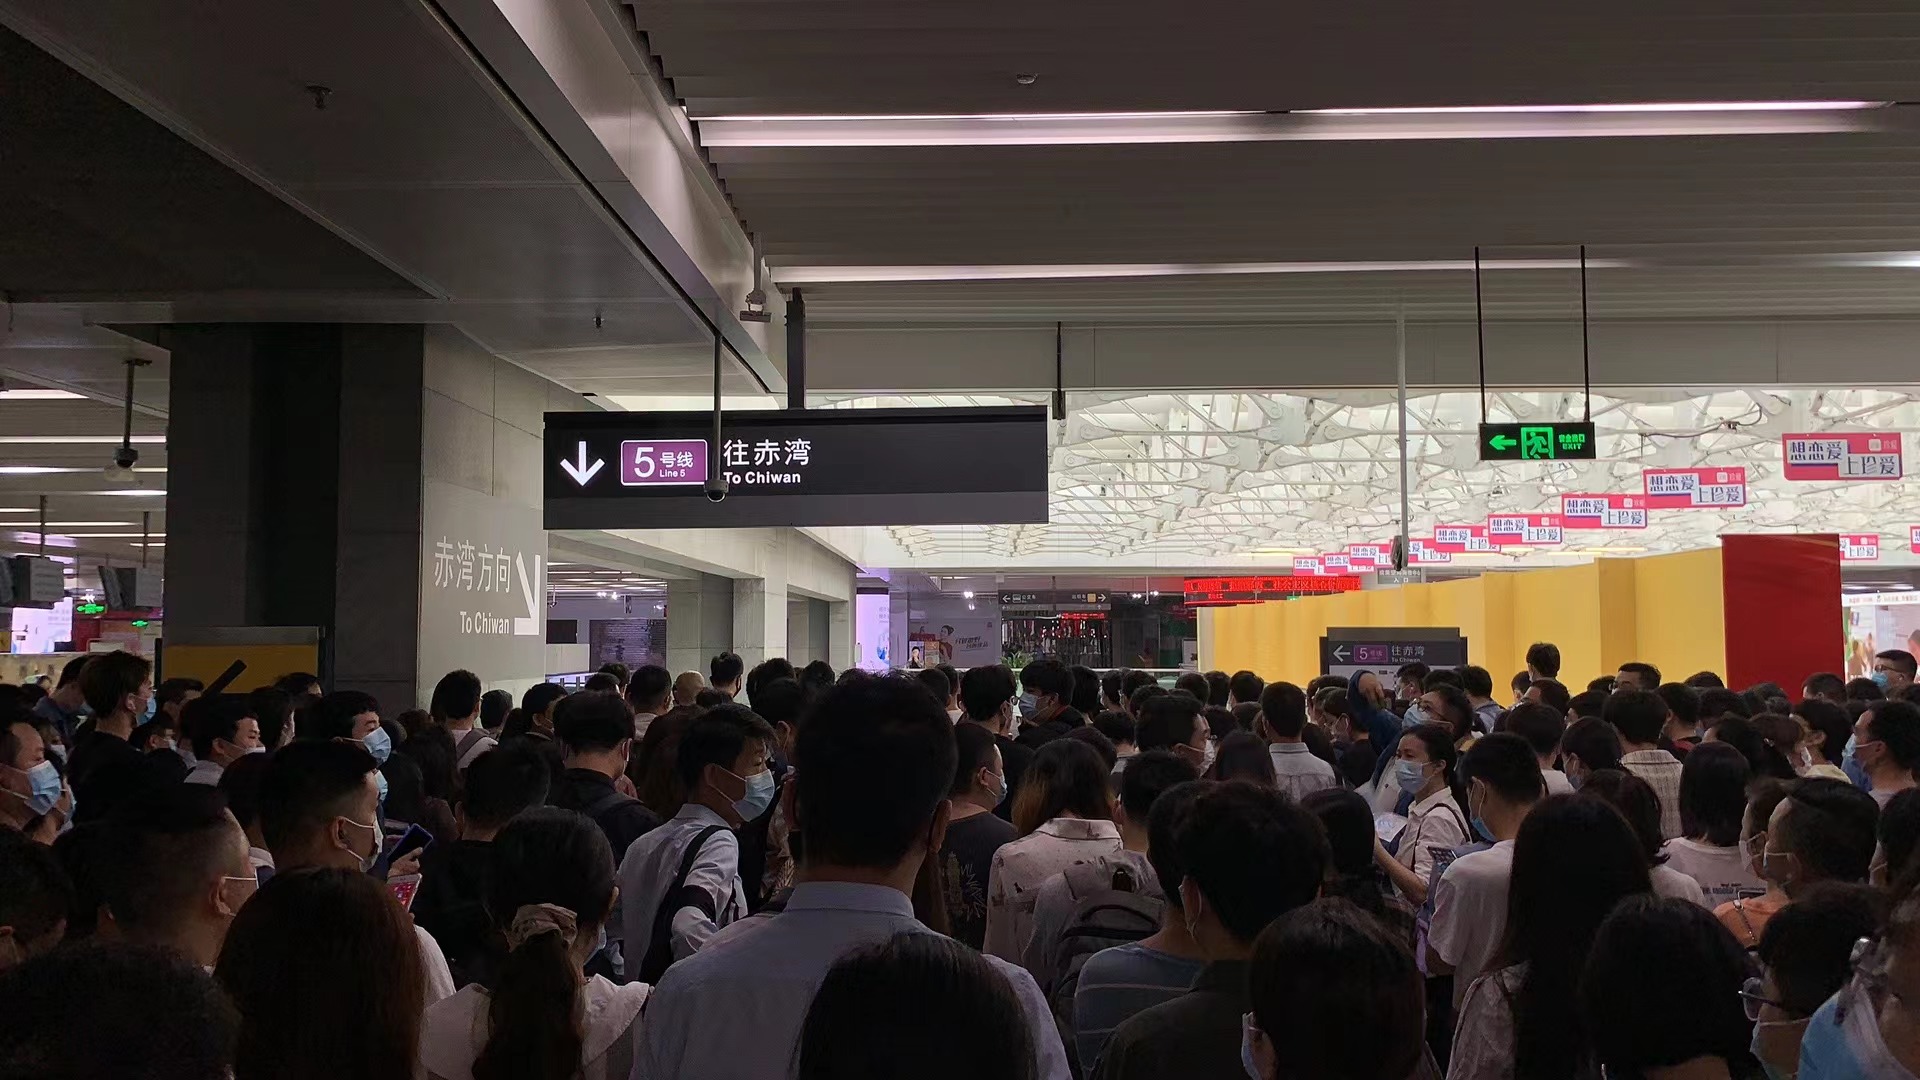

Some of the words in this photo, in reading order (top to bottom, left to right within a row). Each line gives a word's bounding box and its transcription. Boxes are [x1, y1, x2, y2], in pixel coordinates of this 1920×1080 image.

[723, 438, 811, 468] 往赤湾
[1790, 441, 1842, 461] 想恋爱
[659, 468, 678, 478] Line
[679, 468, 686, 477] 5
[1843, 455, 1897, 475] 上珍爱
[724, 472, 741, 484] To
[745, 471, 801, 484] Chiwan
[1649, 474, 1695, 492] 想恋爱
[1696, 485, 1741, 503] 上珍爱
[1566, 499, 1605, 514] 想恋爱
[1491, 518, 1525, 532] 想恋爱
[1605, 510, 1643, 525] 上珍爱
[434, 535, 511, 593] 赤湾方向
[459, 611, 472, 634] To
[474, 611, 510, 634] Chiwan
[1391, 645, 1425, 656] 往赤湾
